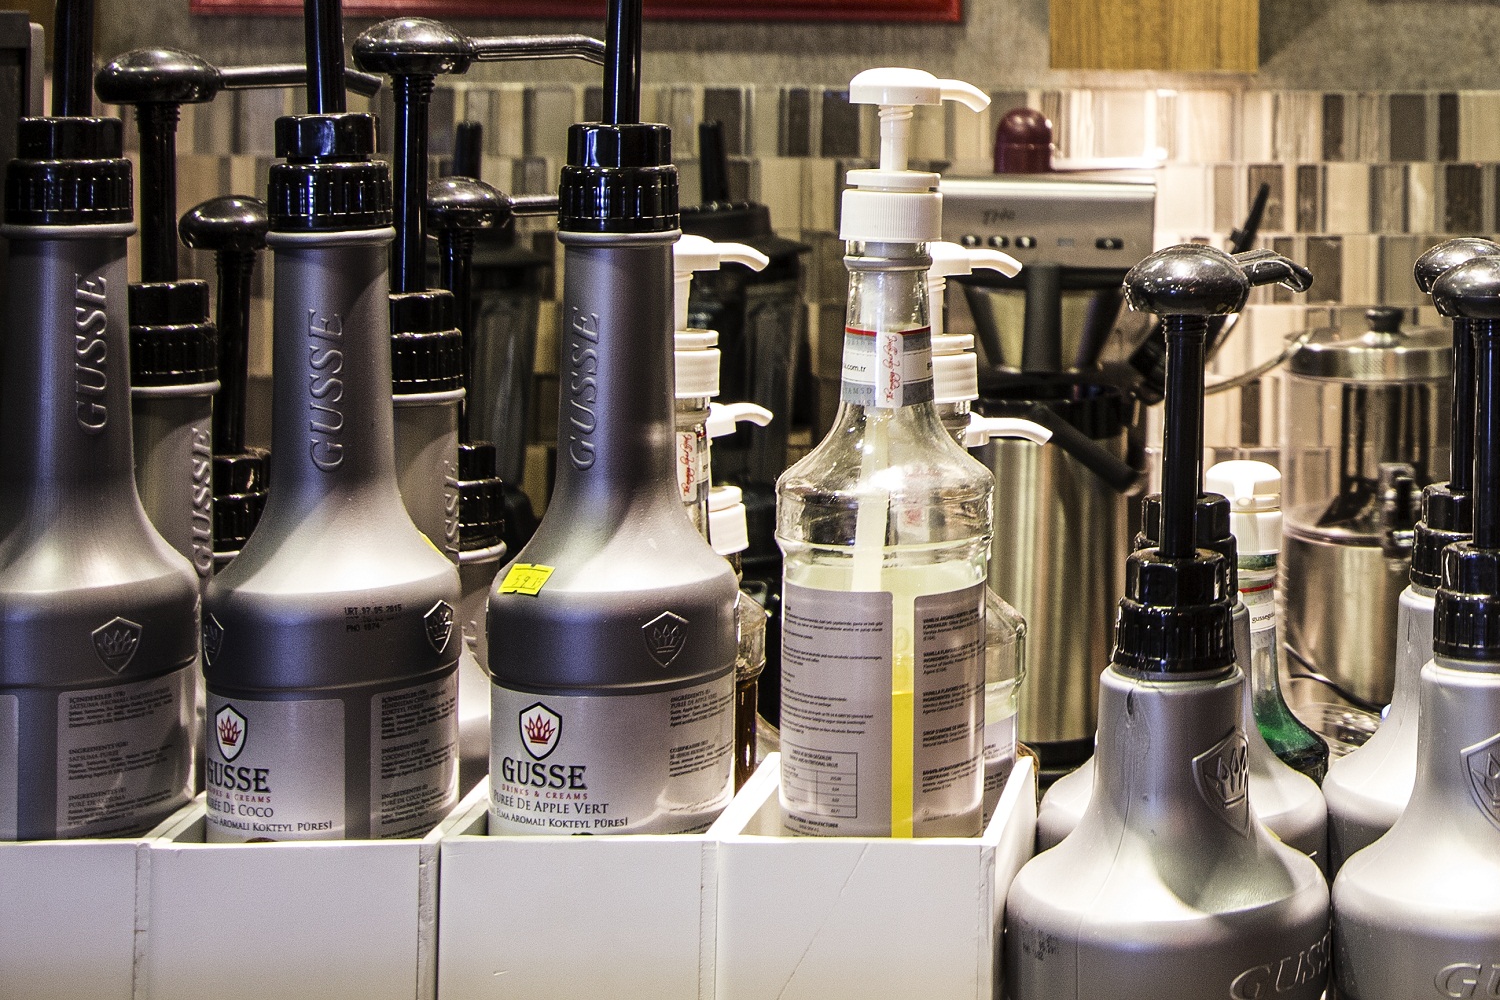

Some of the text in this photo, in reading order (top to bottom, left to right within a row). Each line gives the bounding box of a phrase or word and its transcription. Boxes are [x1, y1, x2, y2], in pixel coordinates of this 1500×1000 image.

[75, 273, 107, 435] GUSSE
[309, 309, 344, 472] GUSSE
[569, 305, 599, 472] GUSSE
[206, 757, 271, 793] GUSSE
[502, 756, 588, 791] GUSSE
[234, 793, 271, 804] CREAMS
[501, 783, 588, 801] DRINKS & CREAMS
[238, 804, 274, 818] COCO
[533, 800, 570, 815] APPLE
[573, 802, 609, 814] VERT
[252, 822, 294, 832] KOKTEYL
[297, 820, 333, 832] PÜRESİ
[510, 813, 546, 827] AROMALI
[548, 818, 591, 829] KOKTEYL
[594, 817, 629, 829] PÜRESİ
